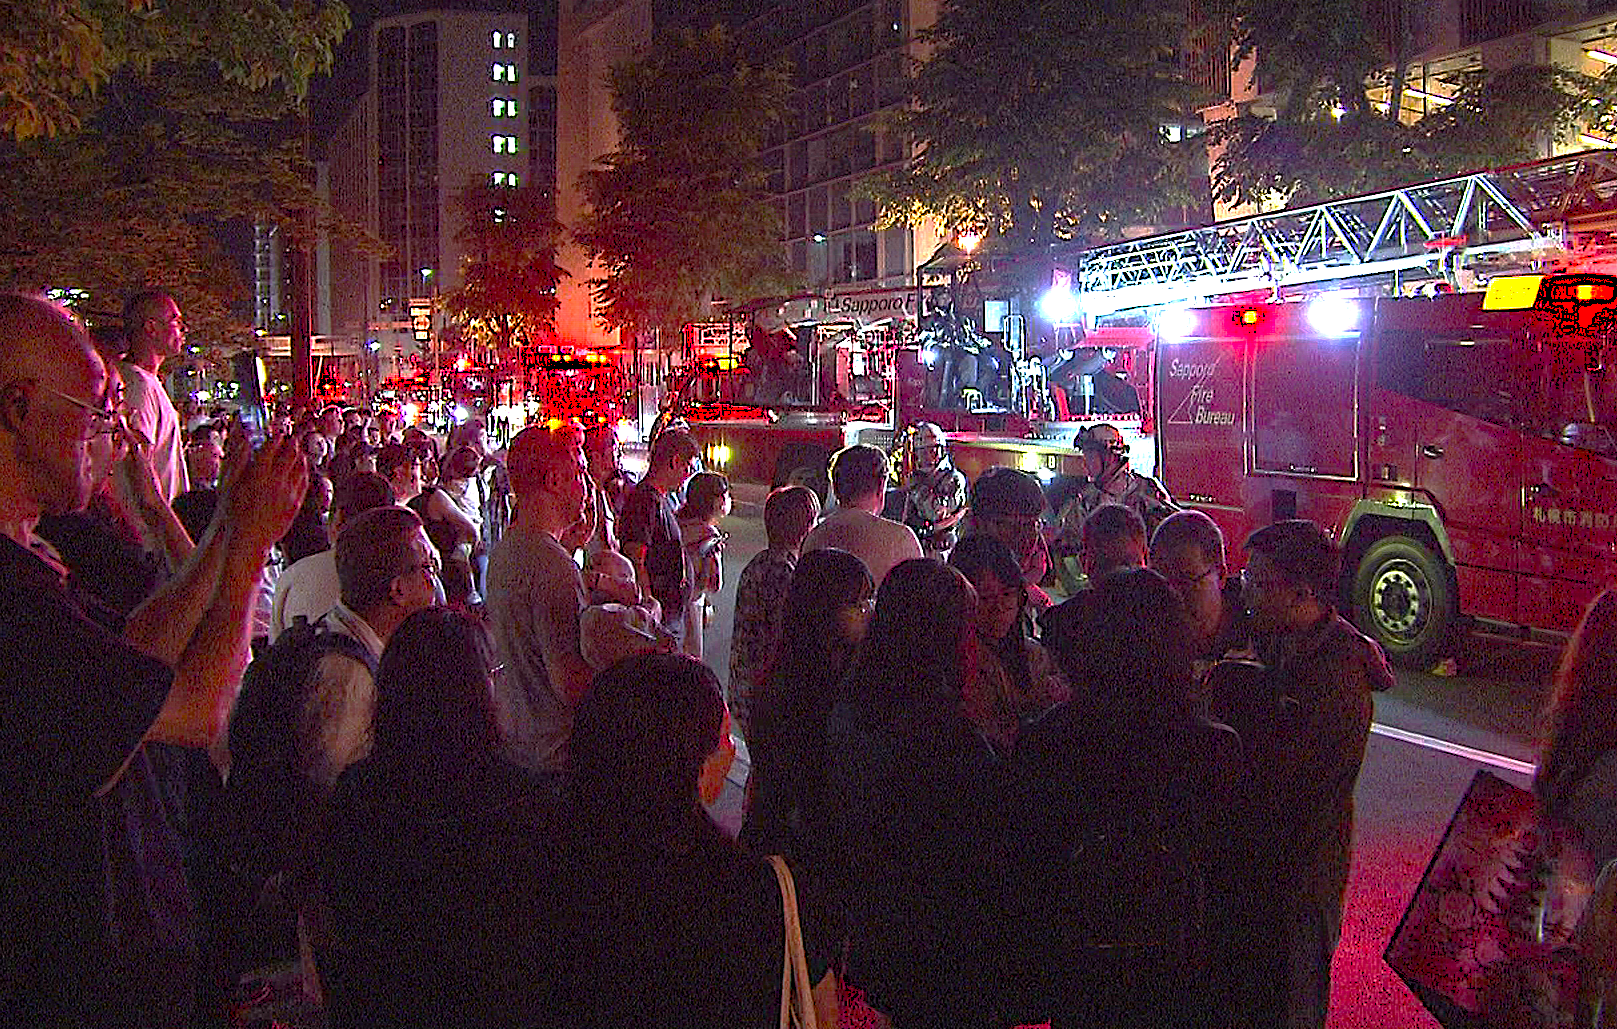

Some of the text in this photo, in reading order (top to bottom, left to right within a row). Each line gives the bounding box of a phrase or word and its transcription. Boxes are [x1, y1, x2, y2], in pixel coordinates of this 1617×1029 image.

[841, 297, 904, 316] Sapporo
[1169, 357, 1214, 380] Sapporo
[1195, 404, 1236, 426] Bureau
[1533, 506, 1617, 529] 札幌市消防
